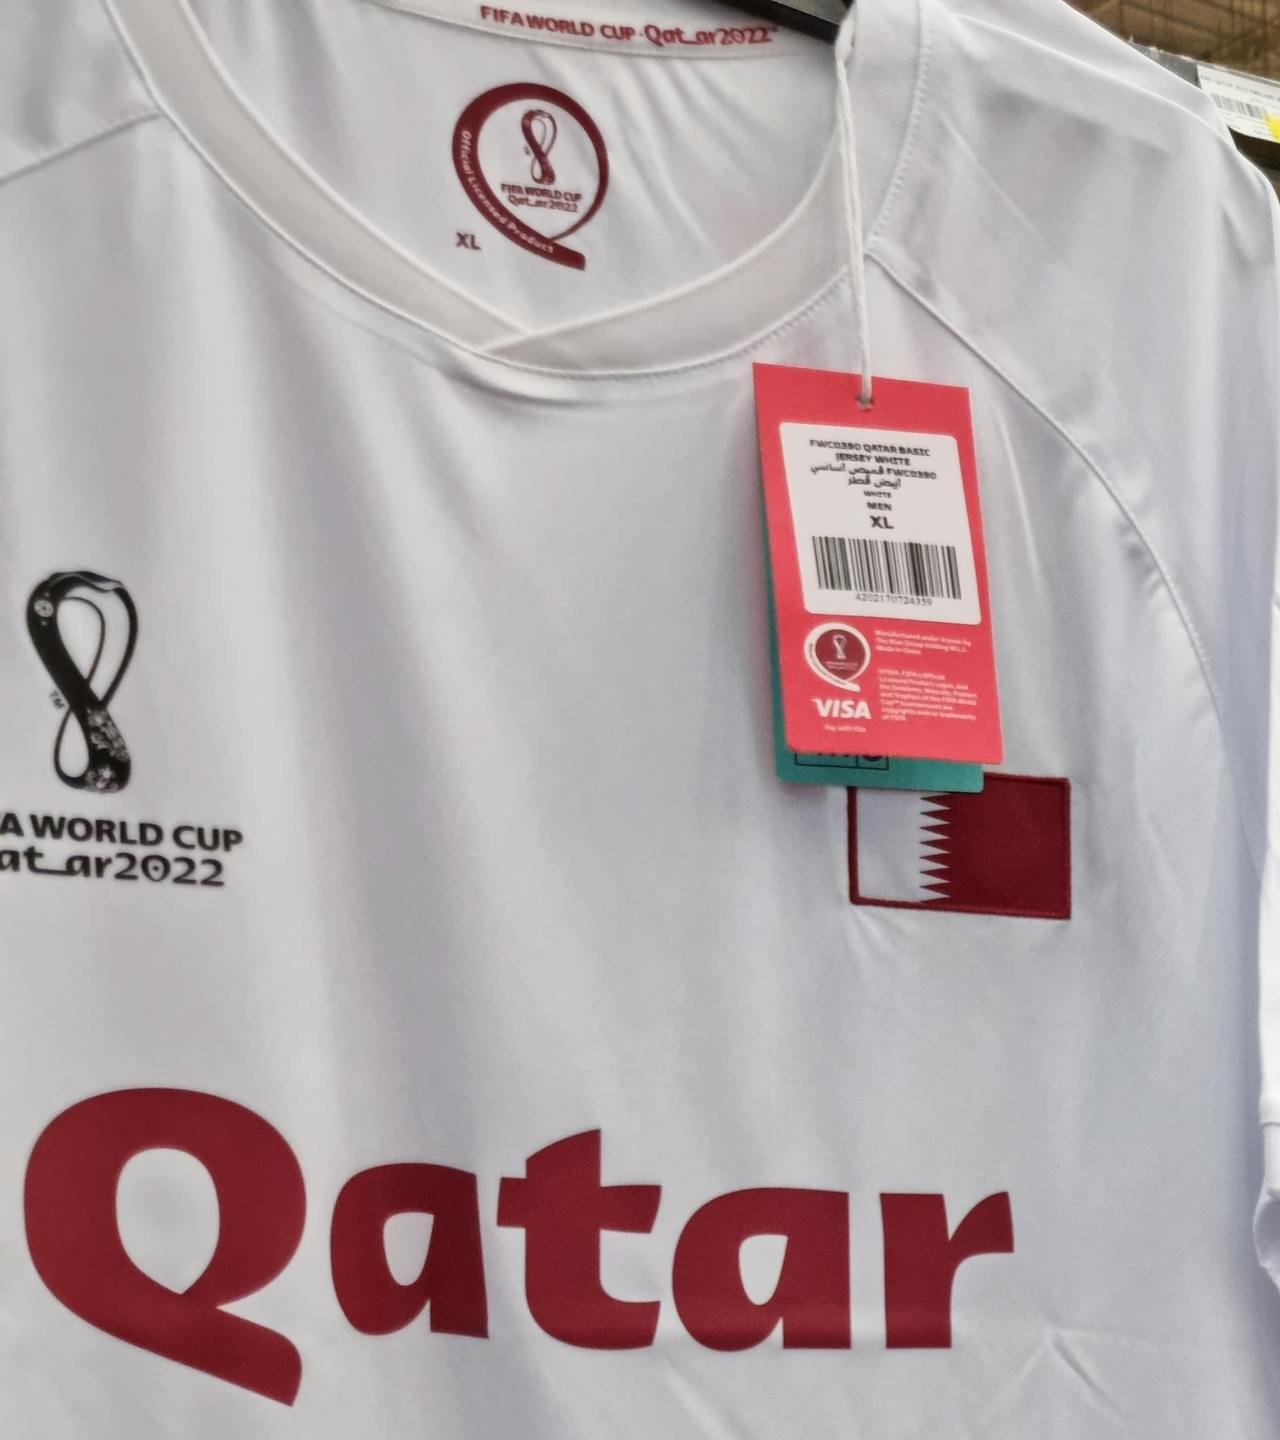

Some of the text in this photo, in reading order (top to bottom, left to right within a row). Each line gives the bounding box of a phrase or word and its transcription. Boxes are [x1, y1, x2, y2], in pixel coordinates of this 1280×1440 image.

[480, 5, 525, 27] FIFA
[525, 15, 595, 37] WORLD
[600, 24, 636, 41] CUP
[456, 231, 482, 251] XL
[835, 453, 911, 467] JERSEY WHITE
[863, 443, 898, 455] QATAR
[899, 446, 931, 457] BASIC
[867, 502, 893, 511] MEN
[869, 516, 894, 529] XL
[812, 698, 872, 720] VISA
[29, 813, 164, 846] WORLD
[172, 825, 243, 852] CUP
[23, 1087, 1015, 1407] Qatar
